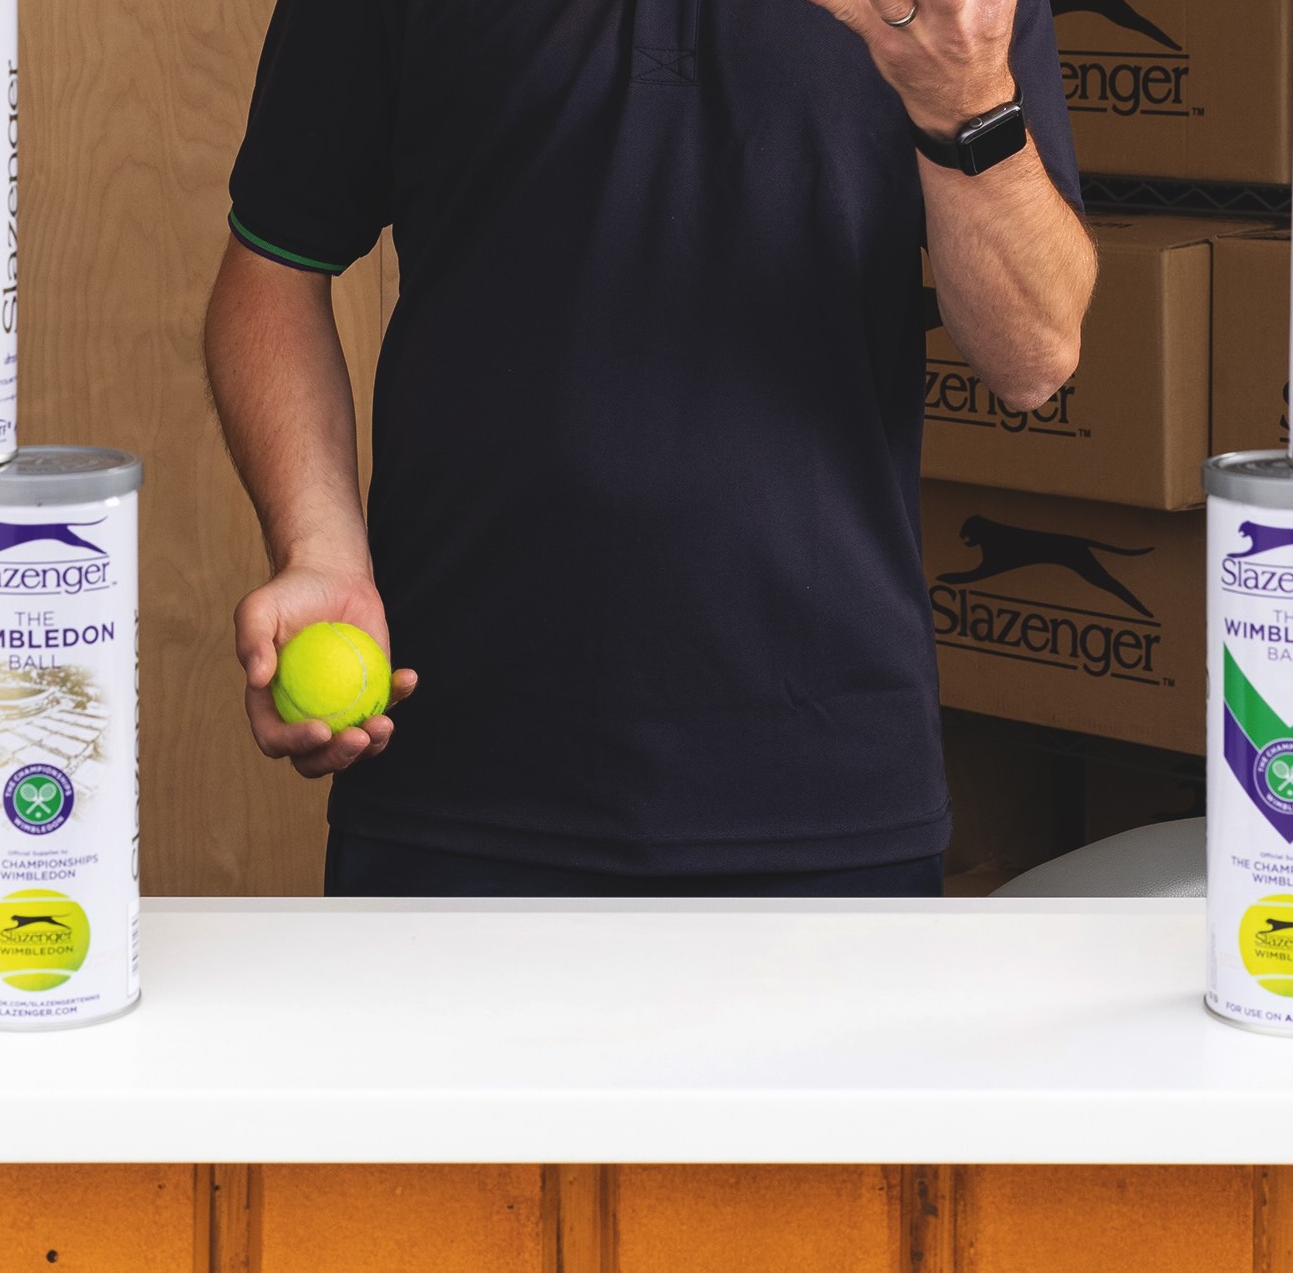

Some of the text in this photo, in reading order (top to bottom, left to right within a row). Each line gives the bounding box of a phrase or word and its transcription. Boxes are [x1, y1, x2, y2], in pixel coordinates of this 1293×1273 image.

[1060, 62, 1189, 116] enger
[15, 612, 54, 626] THE
[931, 584, 1160, 676] Slazenger
[9, 655, 61, 670] BALL
[2, 854, 98, 869] CHAMPIONSHIPS
[1231, 856, 1250, 869] THE
[0, 870, 76, 881] WIMBLEDON
[0, 946, 74, 955] WIMBLEDON
[1226, 1002, 1241, 1014] FOR
[1244, 1008, 1263, 1019] USE
[1266, 1011, 1282, 1021] ON
